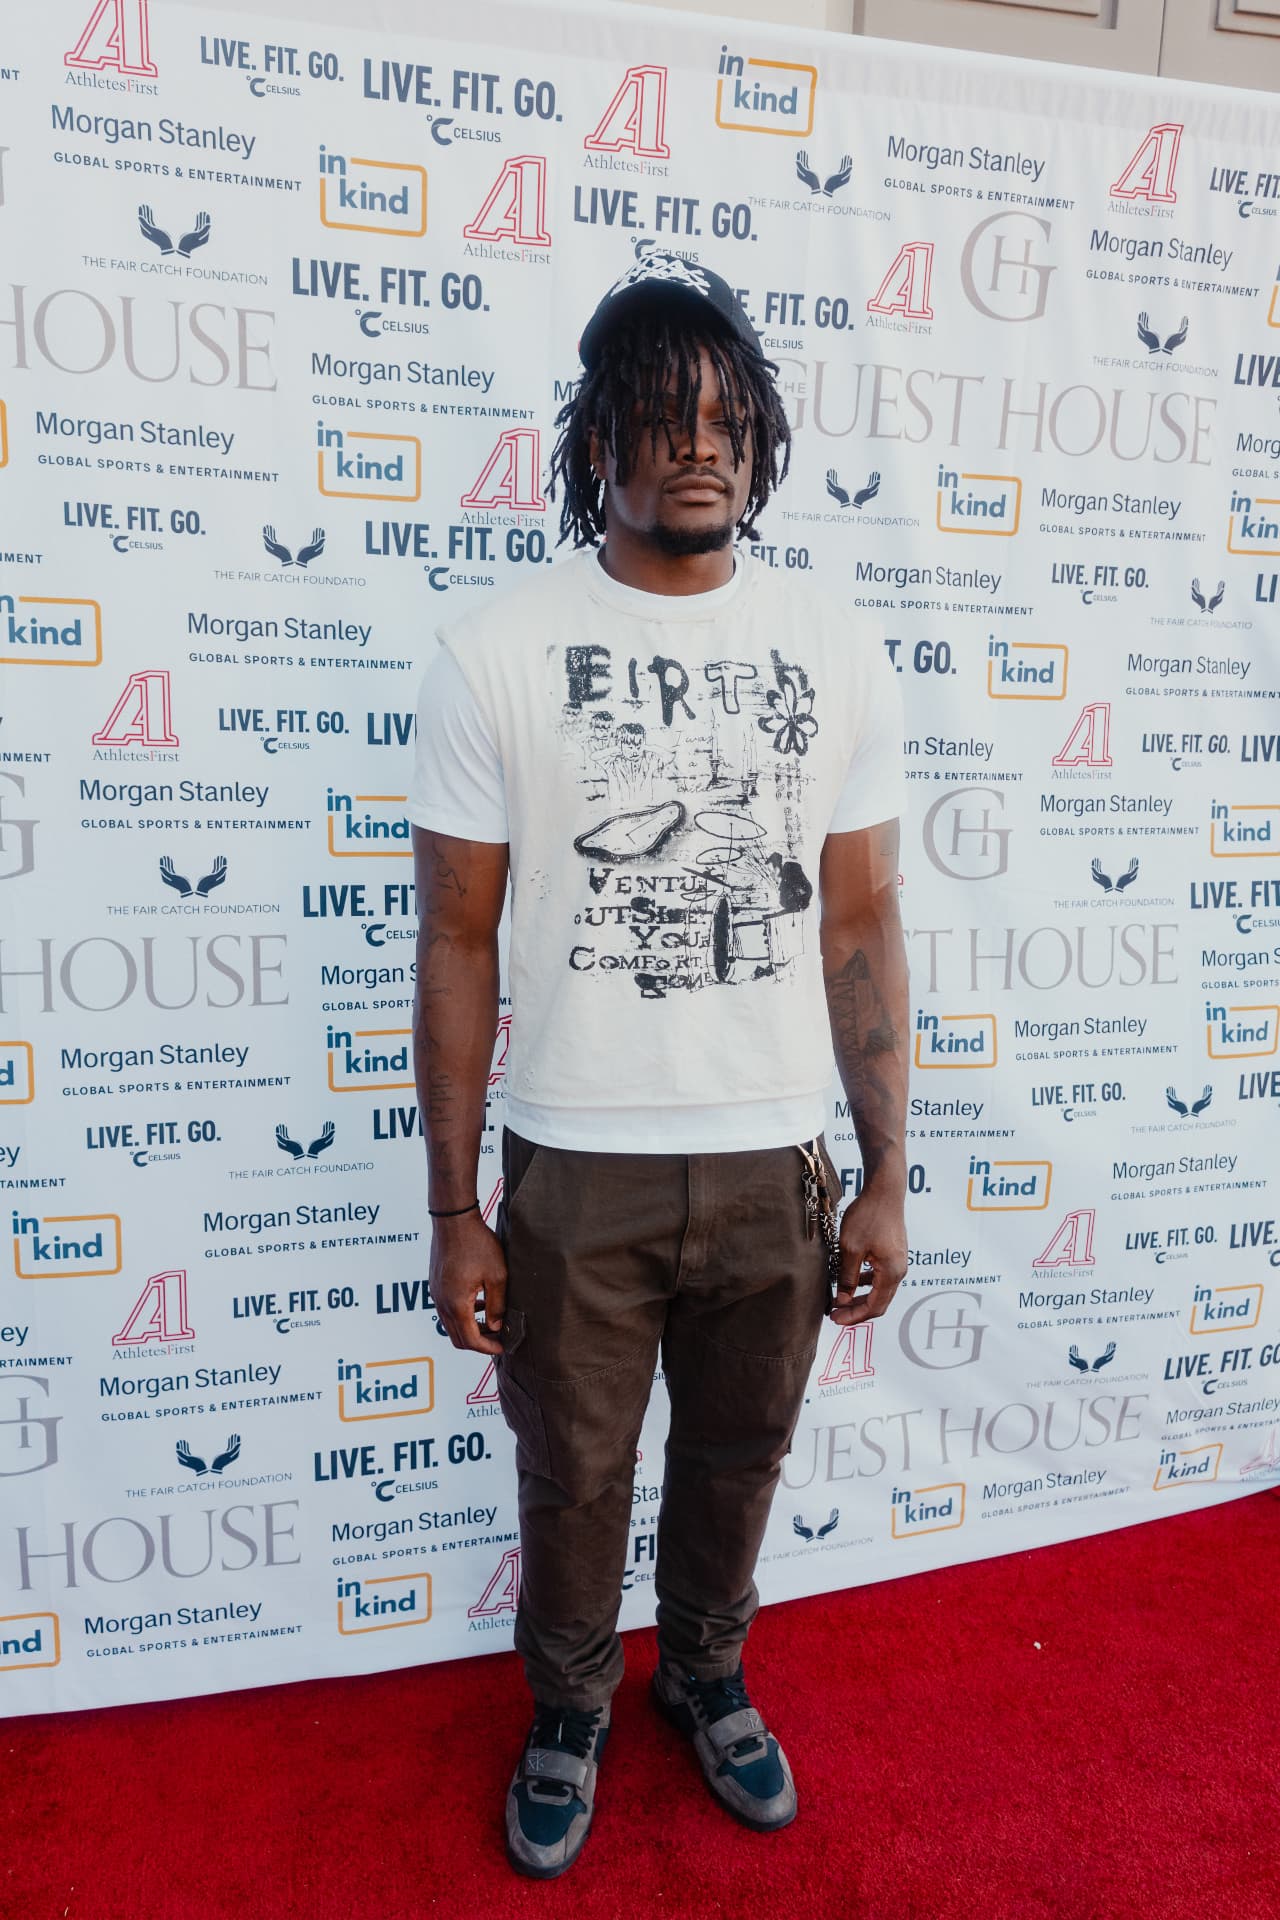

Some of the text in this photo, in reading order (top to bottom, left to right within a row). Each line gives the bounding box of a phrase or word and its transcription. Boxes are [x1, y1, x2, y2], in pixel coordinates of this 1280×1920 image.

[200, 35, 345, 82] LIVE. FIT. GO.
[717, 44, 745, 77] in
[363, 57, 563, 123] LIVE. FIT. GO.
[733, 78, 798, 115] kind
[51, 104, 257, 161] Morgan Stanley
[453, 127, 502, 143] CELSIUS
[53, 151, 302, 192] GLOBAL SPORTS & ENTERTAINMENT
[319, 144, 347, 176] in
[887, 135, 1046, 183] Morgan Stanley
[339, 177, 409, 216] kind
[883, 177, 1076, 210] GLOBAL SPORTS & ENTERTAINMENT
[573, 185, 758, 242] LIVE. FIT. GO.
[1089, 229, 1234, 272] Morgan Stanley
[81, 255, 268, 286] THE FAIR CATCH FOUNDATION
[292, 257, 490, 312] LIVE. FIT. GO.
[382, 320, 430, 335] CELSIUS
[764, 337, 804, 350] CELSIUS
[311, 352, 495, 394] Morgan Stanley
[311, 394, 535, 420] GLOBAL SPORTS & ENTERTAINMENT
[995, 377, 1218, 467] HOUSE
[36, 411, 235, 456] Morgan Stanley
[317, 419, 344, 449] in
[336, 450, 403, 482] kind
[937, 463, 959, 489] in
[951, 490, 1007, 518] kind
[1041, 487, 1182, 521] Morgan Stanley
[365, 520, 553, 564] LIVE. FIT. GO.
[449, 574, 495, 586] CELSIUS
[855, 561, 1002, 595] Morgan Stanley
[1051, 562, 1149, 589] LIVE. FIT. GO.
[854, 598, 1034, 616] GLOBAL SPORTS & ENTERTAINMENT
[7, 615, 82, 646] kind
[187, 612, 372, 647] Morgan Stanley
[988, 633, 1009, 658] in
[188, 652, 413, 671] GLOBAL SPORTS & ENTERTAINMENT
[1001, 658, 1055, 684] kind
[1127, 653, 1252, 680] Morgan Stanley
[79, 779, 269, 808] Morgan Stanley
[1040, 794, 1173, 817] Morgan Stanley
[1210, 798, 1229, 820] in
[80, 819, 312, 830] GLOBAL SPORTS & ENTERTAINMENT
[1223, 820, 1271, 842] kind
[302, 884, 375, 918] LIVE.
[967, 923, 1179, 992] HOUSE
[916, 1008, 939, 1031] in
[1014, 1015, 1148, 1041] Morgan Stanley
[326, 1024, 352, 1049] in
[930, 1030, 985, 1054] kind
[61, 1042, 249, 1073] Morgan Stanley
[345, 1046, 408, 1074] kind
[1031, 1081, 1126, 1107] LIVE. FIT. GO.
[86, 1119, 222, 1150] LIVE. FIT. GO.
[968, 1155, 991, 1175] in
[1113, 1153, 1238, 1182] Morgan Stanley
[982, 1175, 1037, 1197] kind
[11, 1209, 40, 1235] in
[203, 1201, 381, 1234] Morgan Stanley
[32, 1232, 103, 1261] kind
[233, 1286, 360, 1319] LIVE. FIT. GO.
[1019, 1286, 1155, 1310] Morgan Stanley
[99, 1363, 282, 1399] Morgan Stanley
[337, 1358, 363, 1381] in
[356, 1374, 418, 1404] kind
[314, 1431, 492, 1482] LIVE. FIT. GO.
[780, 1393, 1150, 1490] UEST HOUSE
[124, 1471, 293, 1499] THE FAIR CATCH FOUNDATION
[891, 1486, 912, 1505] in
[982, 1469, 1108, 1500] Morgan Stanley
[332, 1506, 498, 1543] Morgan Stanley
[904, 1497, 953, 1524] kind
[15, 1499, 302, 1591] HOUSE
[84, 1602, 262, 1639] Morgan Stanley
